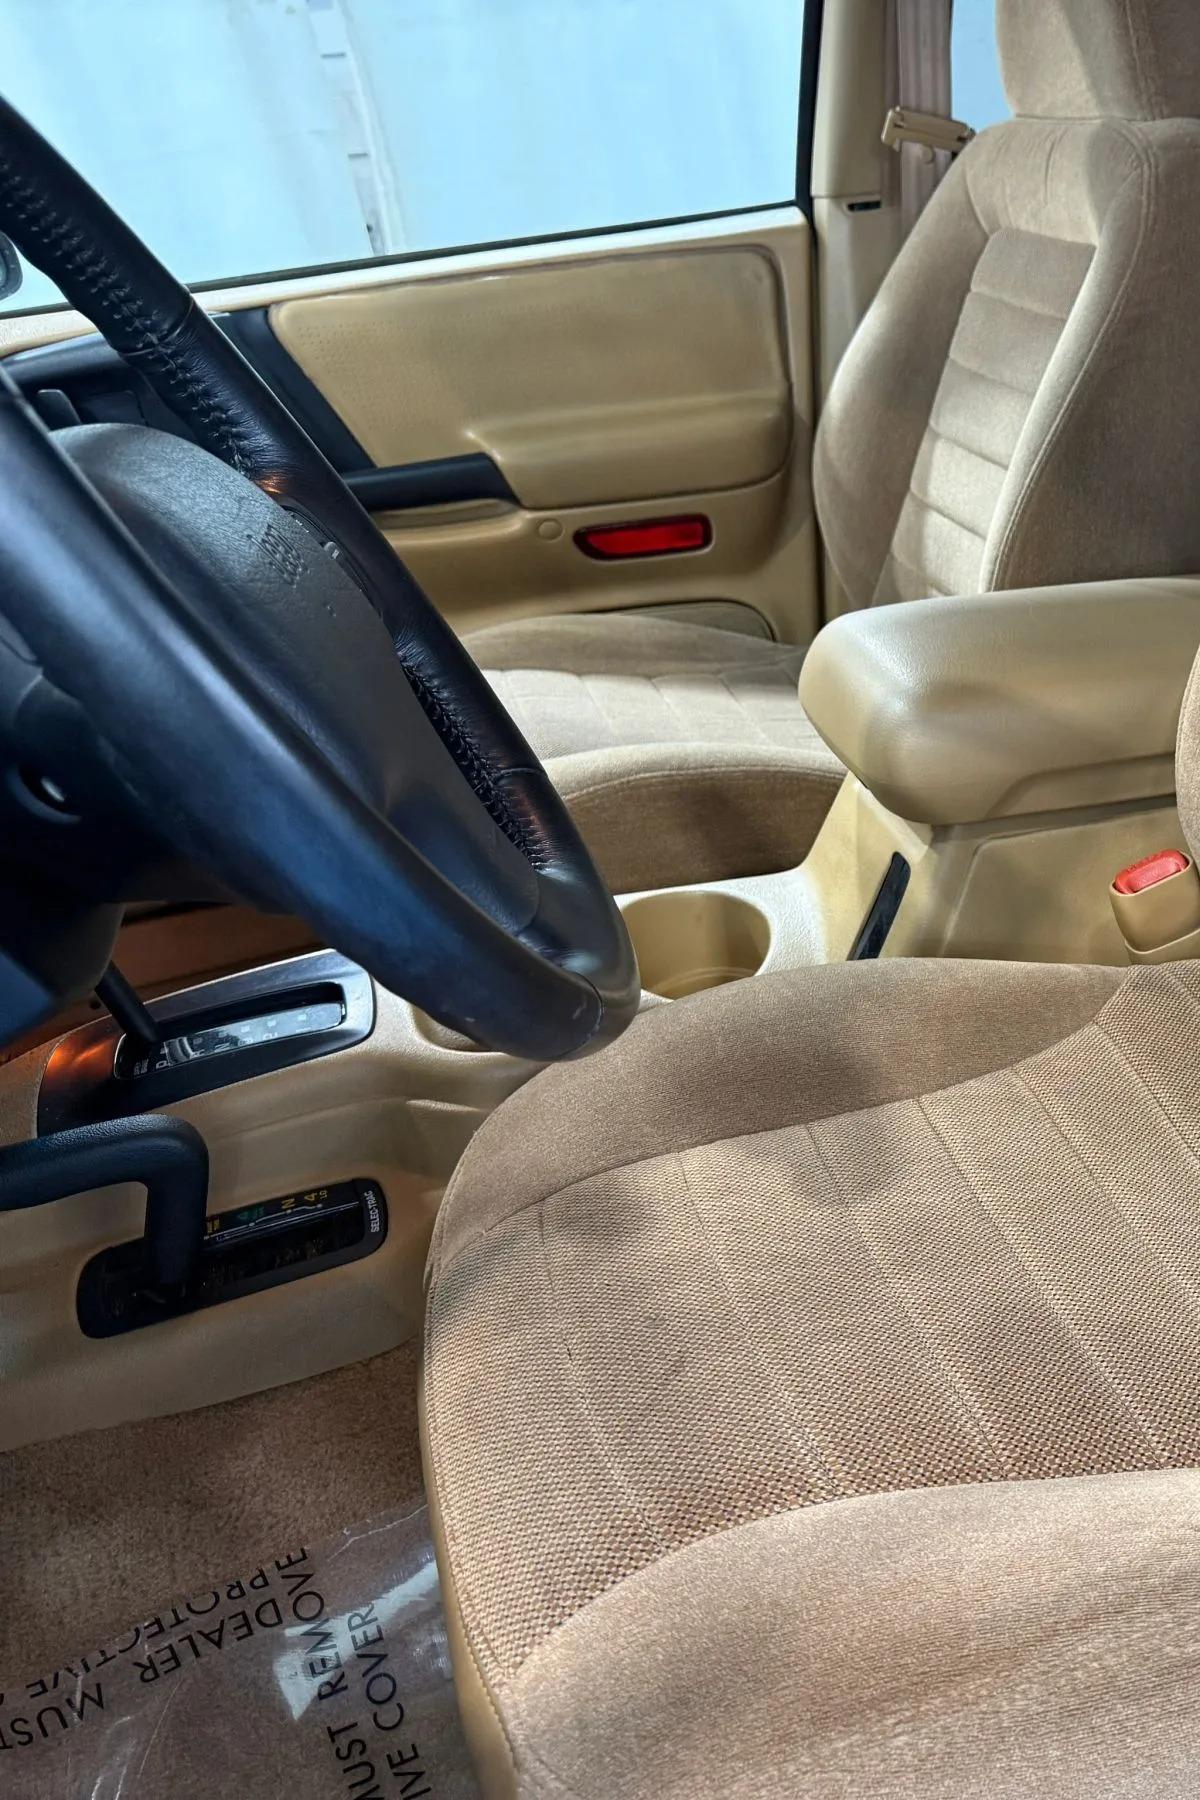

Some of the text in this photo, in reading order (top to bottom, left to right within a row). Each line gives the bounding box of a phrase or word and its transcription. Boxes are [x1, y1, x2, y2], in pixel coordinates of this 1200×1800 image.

[245, 523, 306, 588] Jeep
[133, 1602, 283, 1685] DEALER
[275, 1547, 349, 1701] REMOVE
[347, 1602, 404, 1731] COVER
